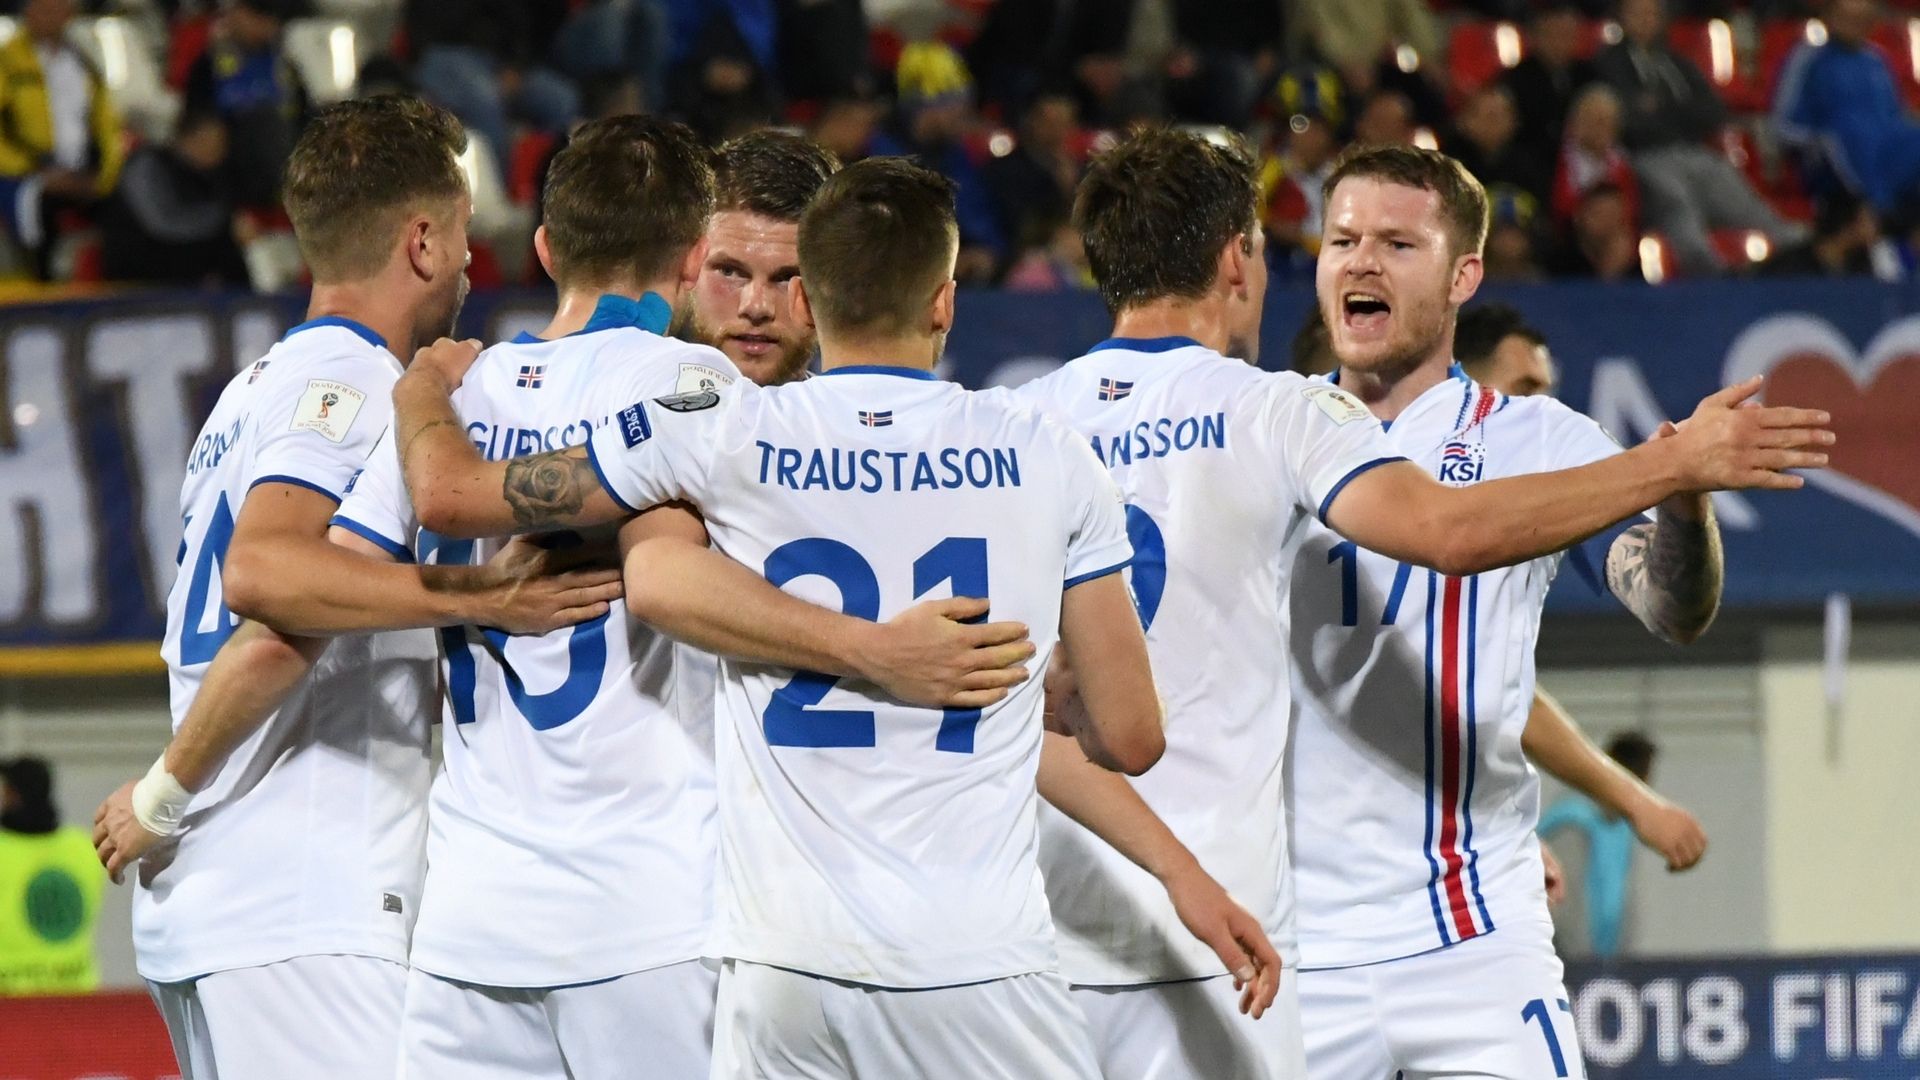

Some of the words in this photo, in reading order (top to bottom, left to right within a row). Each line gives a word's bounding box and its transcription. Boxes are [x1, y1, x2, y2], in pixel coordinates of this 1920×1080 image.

[756, 440, 1021, 493] TRAUSTASON
[763, 537, 989, 754] 21
[1521, 997, 1571, 1078] 1
